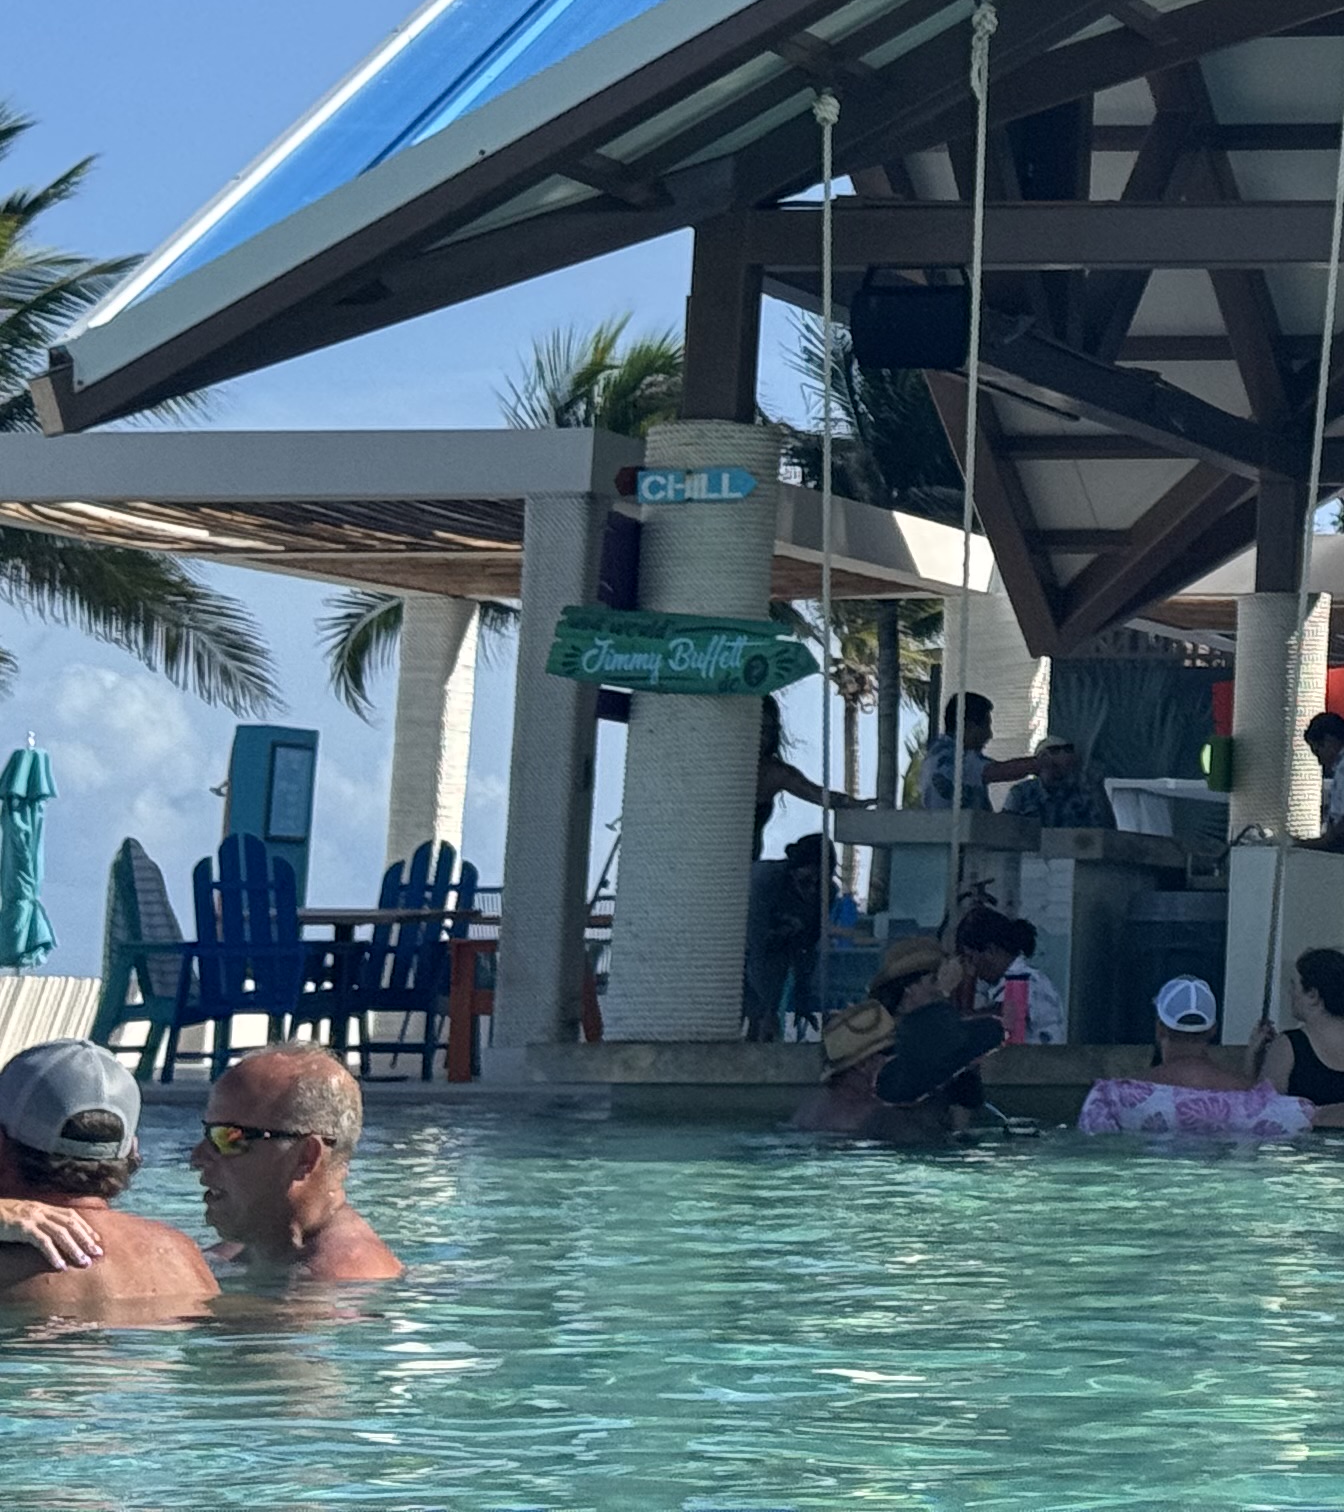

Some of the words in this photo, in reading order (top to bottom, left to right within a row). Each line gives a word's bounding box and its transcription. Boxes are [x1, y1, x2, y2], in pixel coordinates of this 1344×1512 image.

[641, 471, 745, 500] CHILL
[581, 636, 662, 686] Jimmy
[667, 633, 771, 679] Buffett
